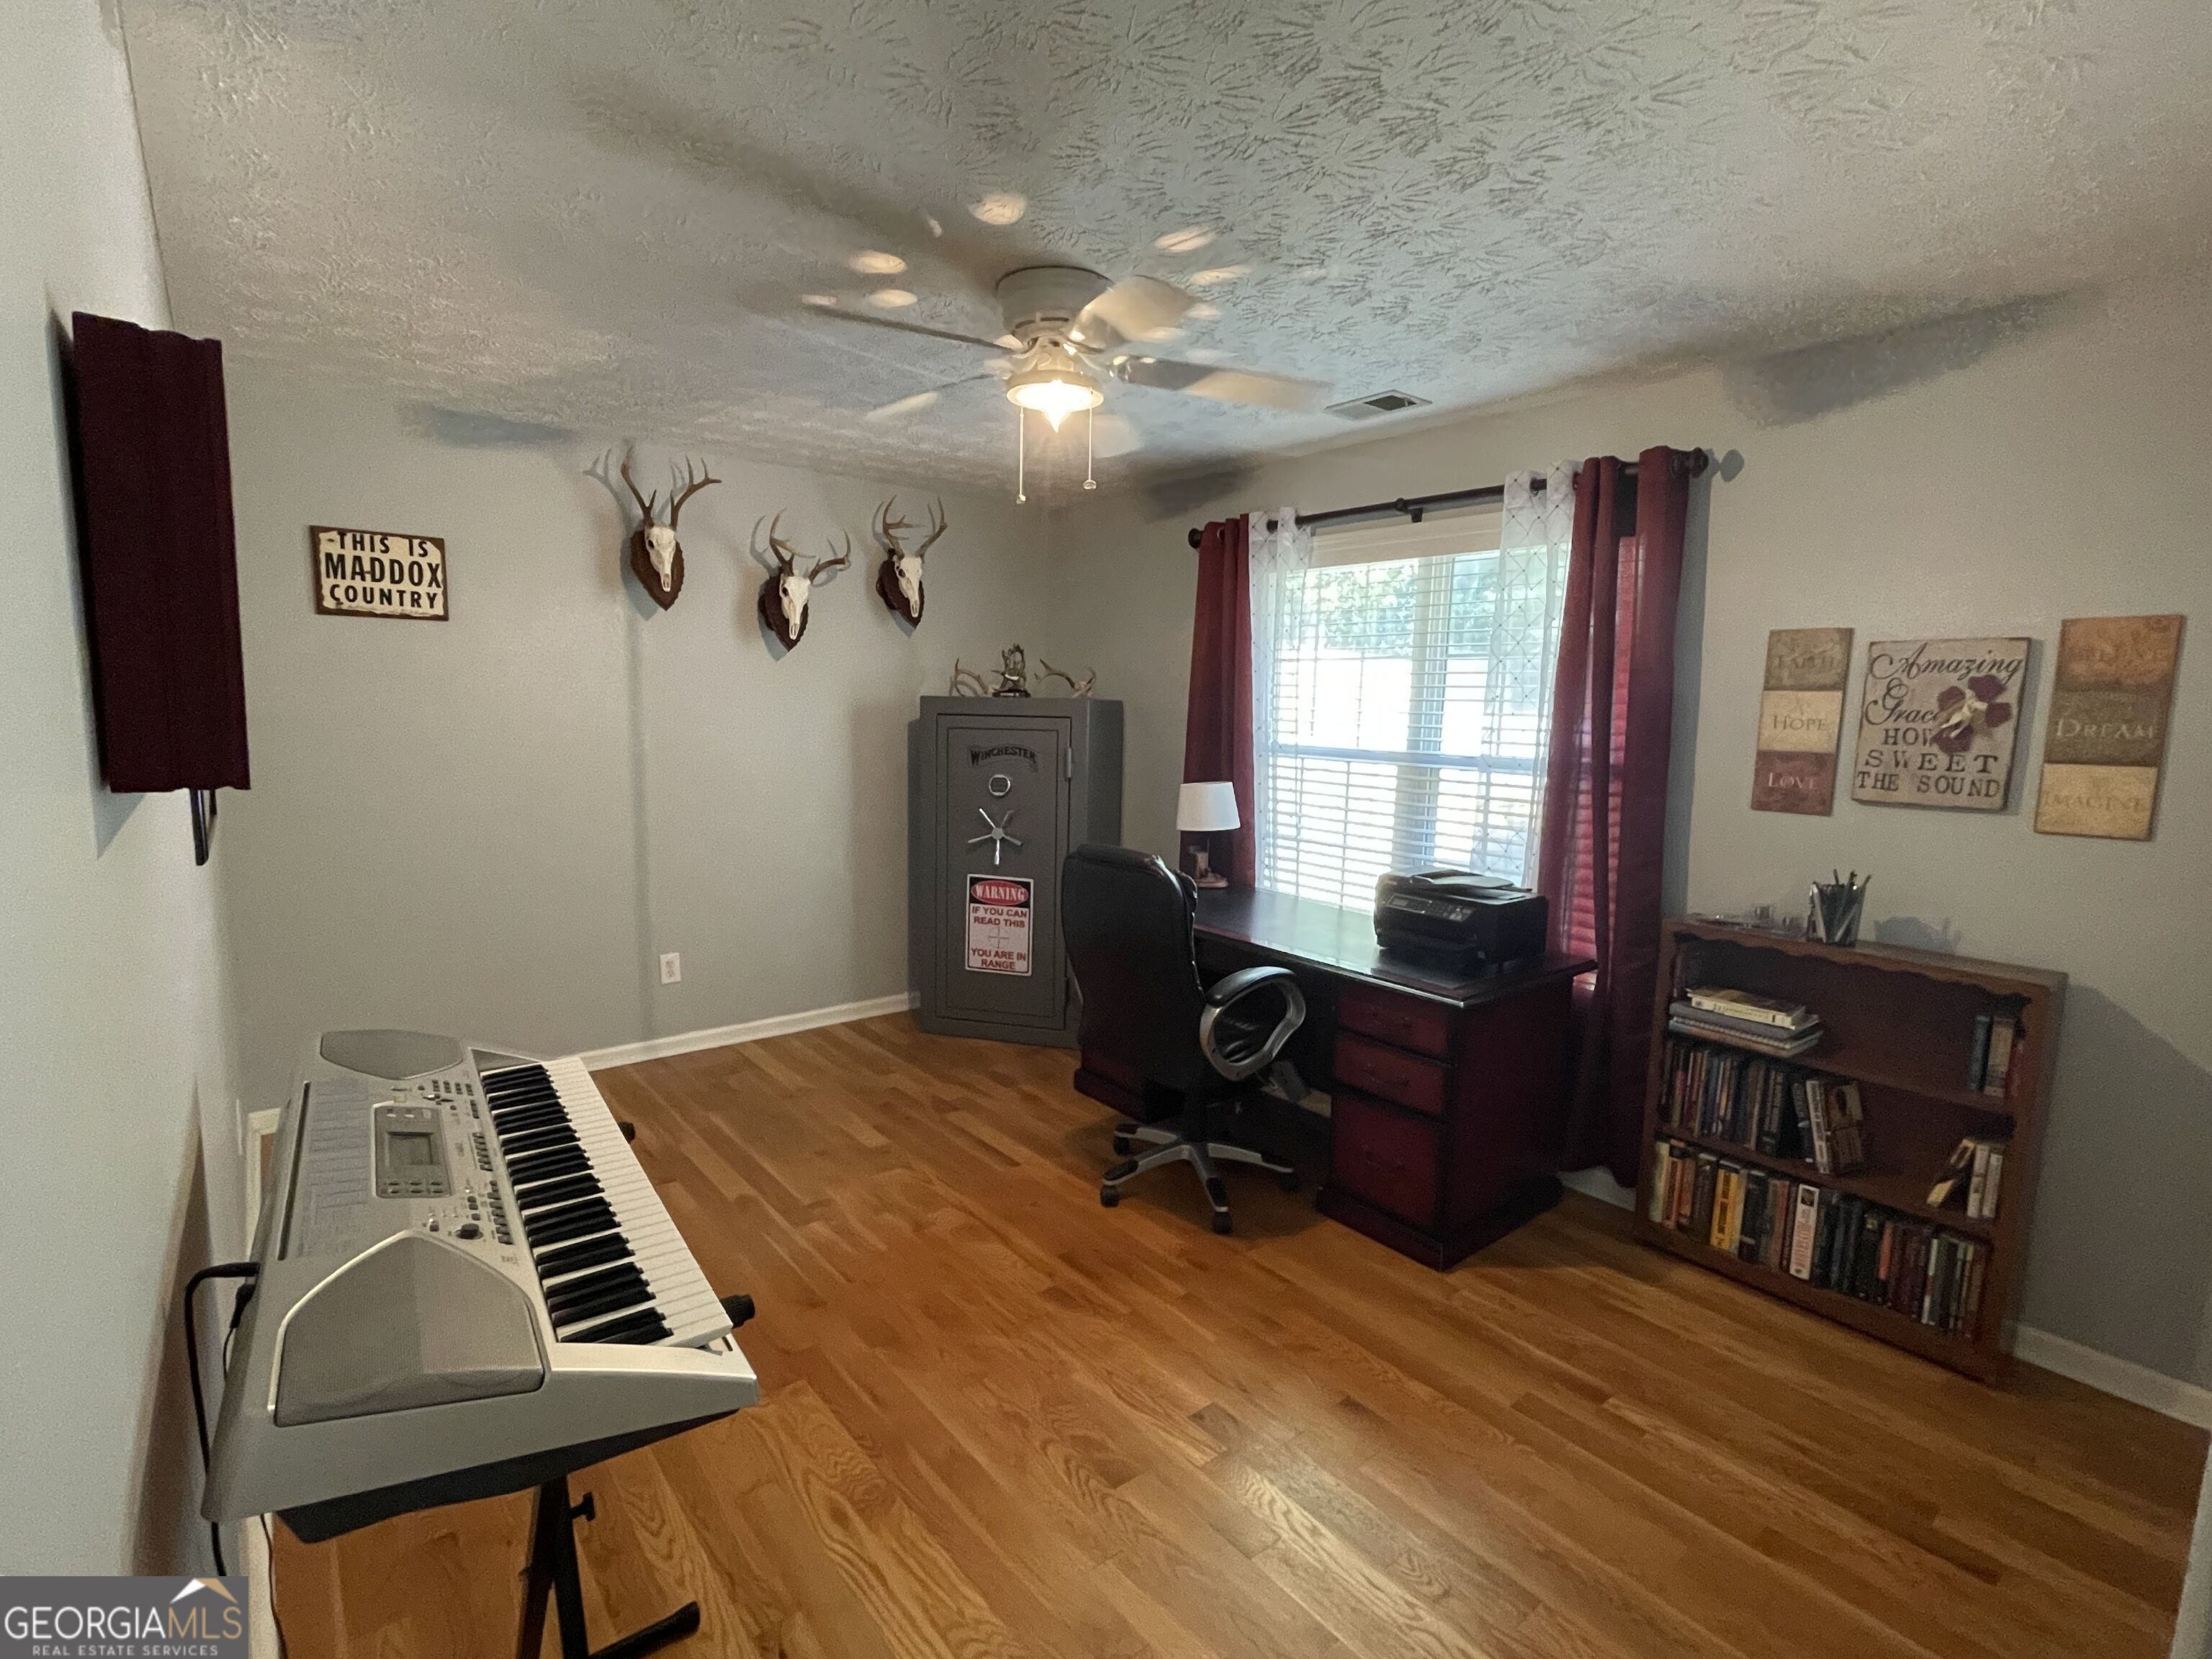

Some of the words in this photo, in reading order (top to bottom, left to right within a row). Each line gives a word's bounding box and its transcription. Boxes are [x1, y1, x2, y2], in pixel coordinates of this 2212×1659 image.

[337, 531, 390, 554] THIS
[408, 539, 428, 557] IS
[325, 552, 441, 588] MADDOX
[330, 584, 438, 609] COUNTRY
[1870, 642, 2025, 685] Amazing
[1773, 715, 1827, 731] HOPE
[970, 745, 1037, 766] WINCHESTER
[1768, 772, 1818, 790] LOVE
[1857, 771, 1899, 792] THE
[1916, 775, 2001, 798] SOUND
[975, 884, 1026, 901] WARNING
[972, 905, 981, 914] IF
[982, 907, 1004, 916] YOU
[1006, 909, 1028, 918] CAN
[974, 916, 1001, 926] READ
[1003, 919, 1025, 928] THIS
[971, 948, 992, 958] YOU
[994, 950, 1014, 960] ARE
[1016, 952, 1026, 961] IN
[981, 958, 1016, 970] RANGE
